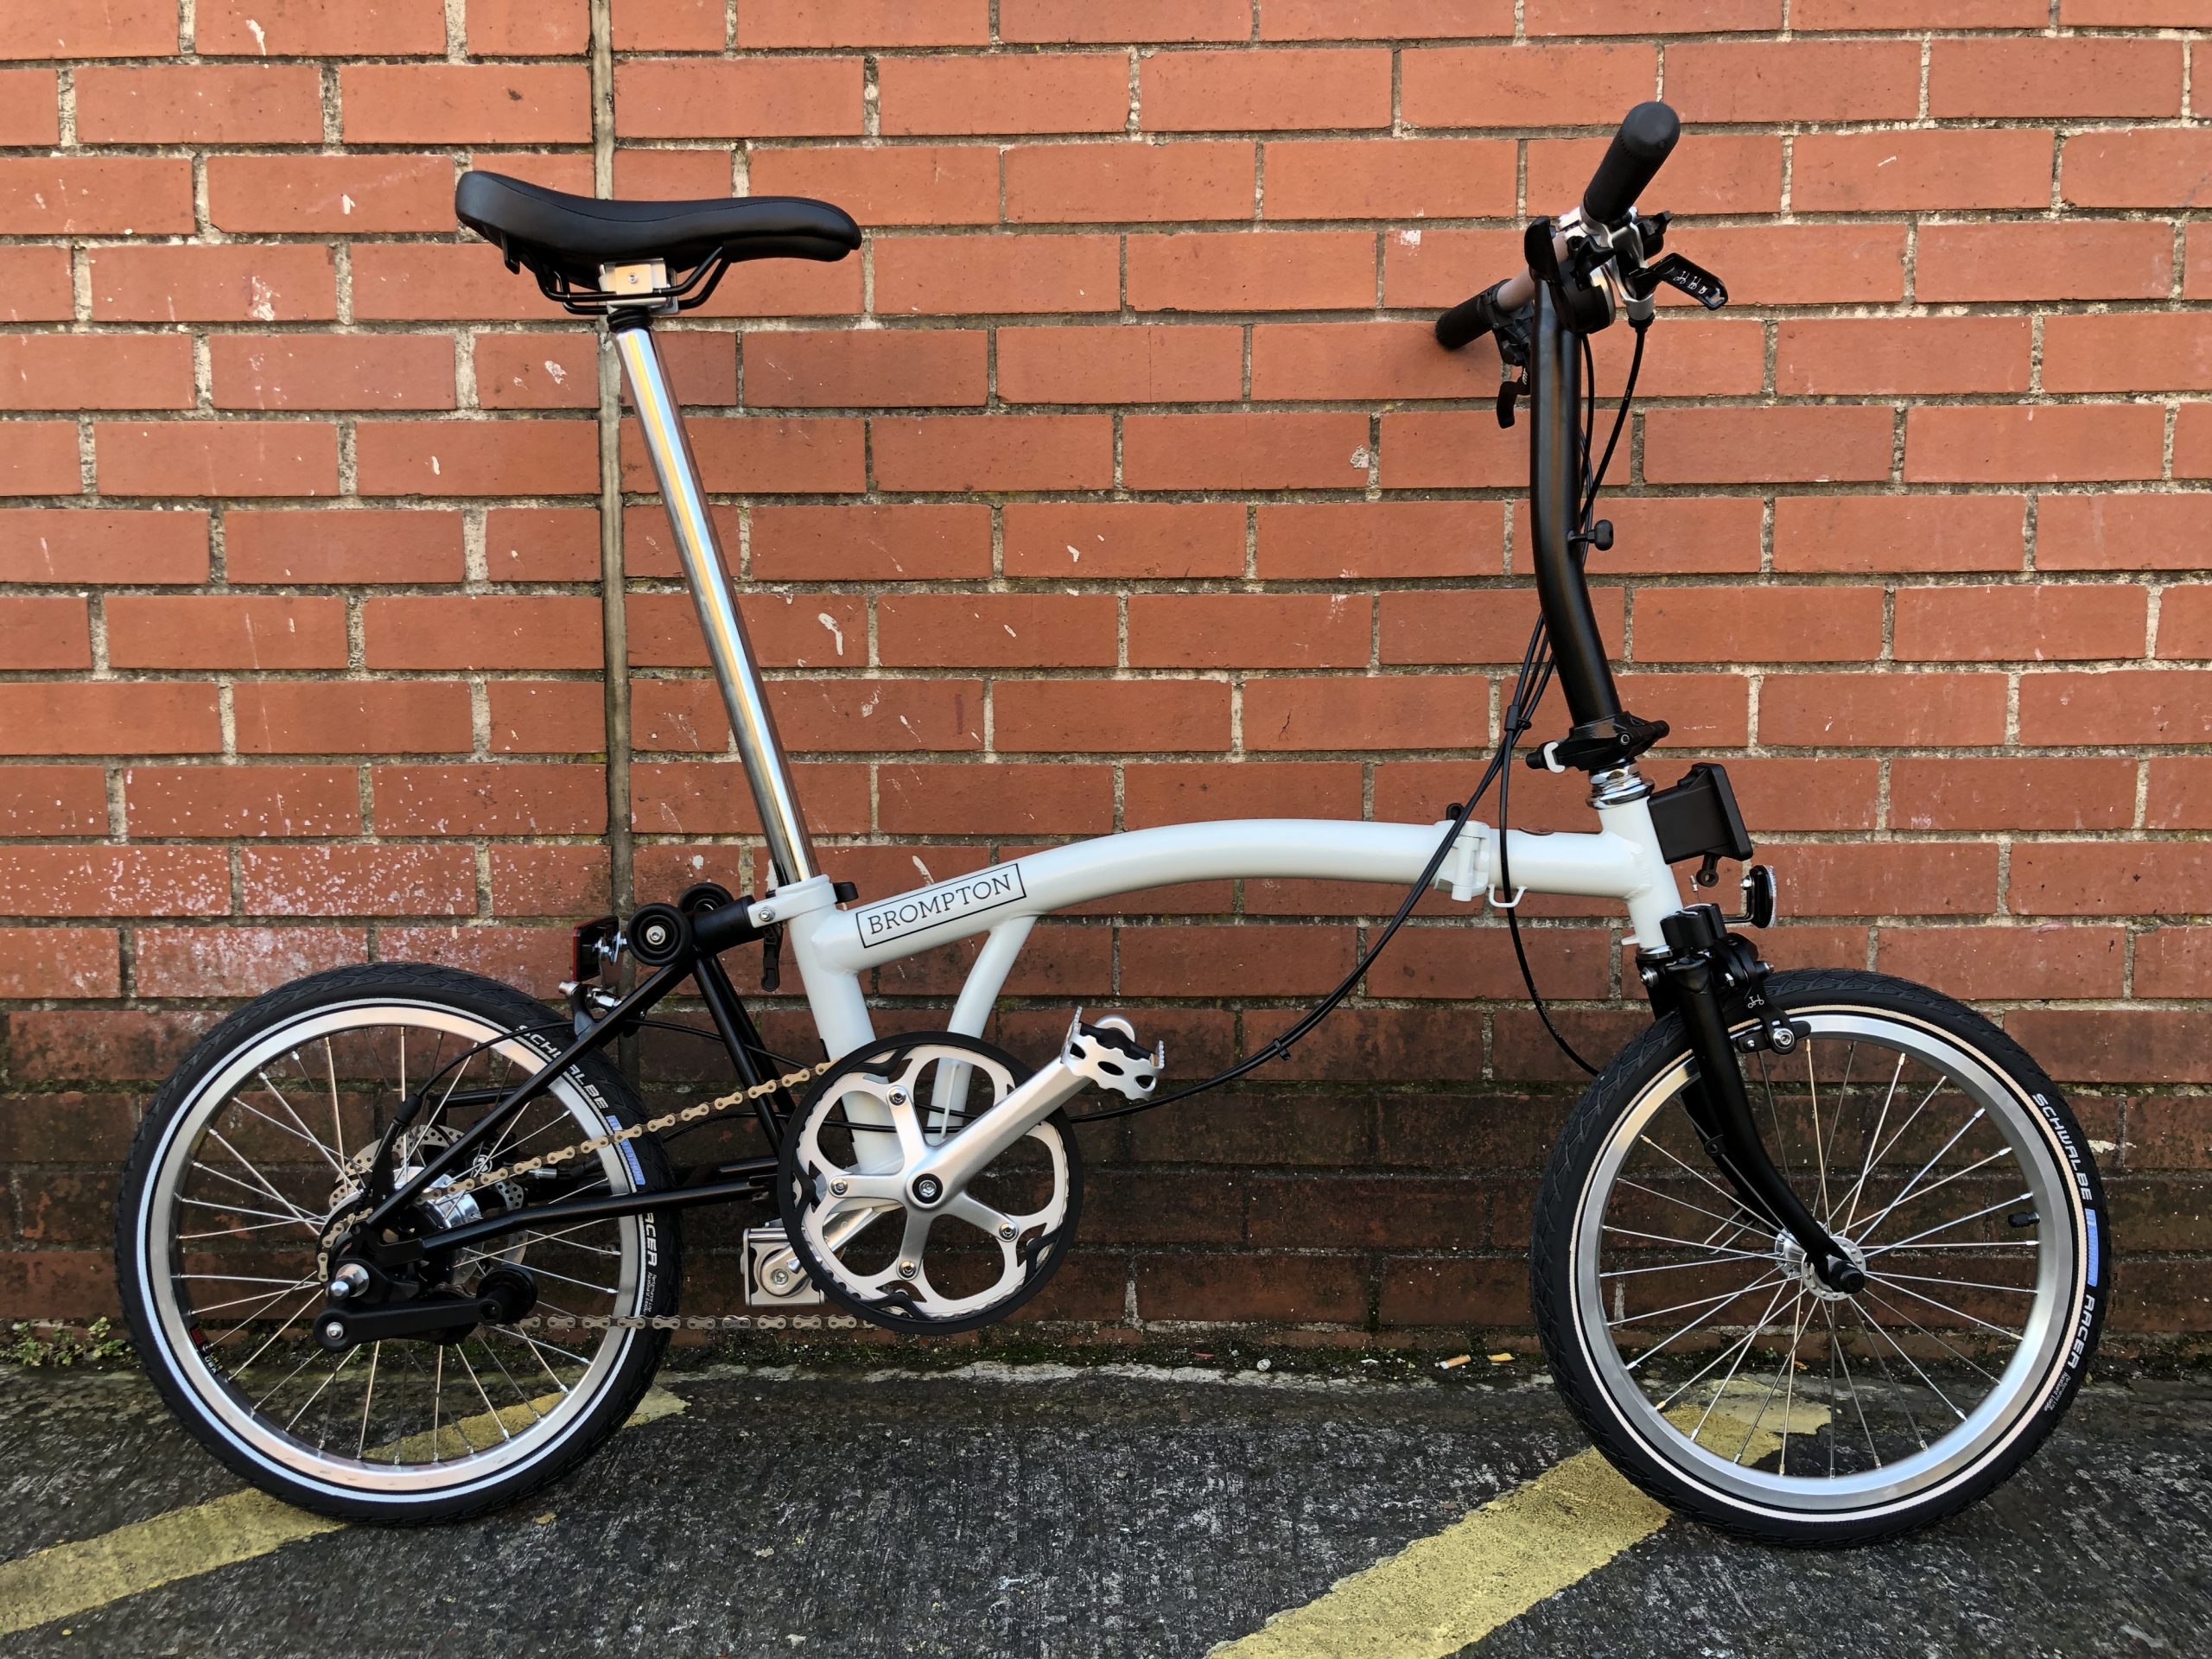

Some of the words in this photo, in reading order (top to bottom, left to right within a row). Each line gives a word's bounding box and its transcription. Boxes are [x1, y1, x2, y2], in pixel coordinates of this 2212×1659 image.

[868, 874, 1011, 935] BROMPTON
[2032, 1093, 2092, 1200] SCHWALBE
[645, 1212, 658, 1267] ACER
[2067, 1294, 2095, 1369] RACER
